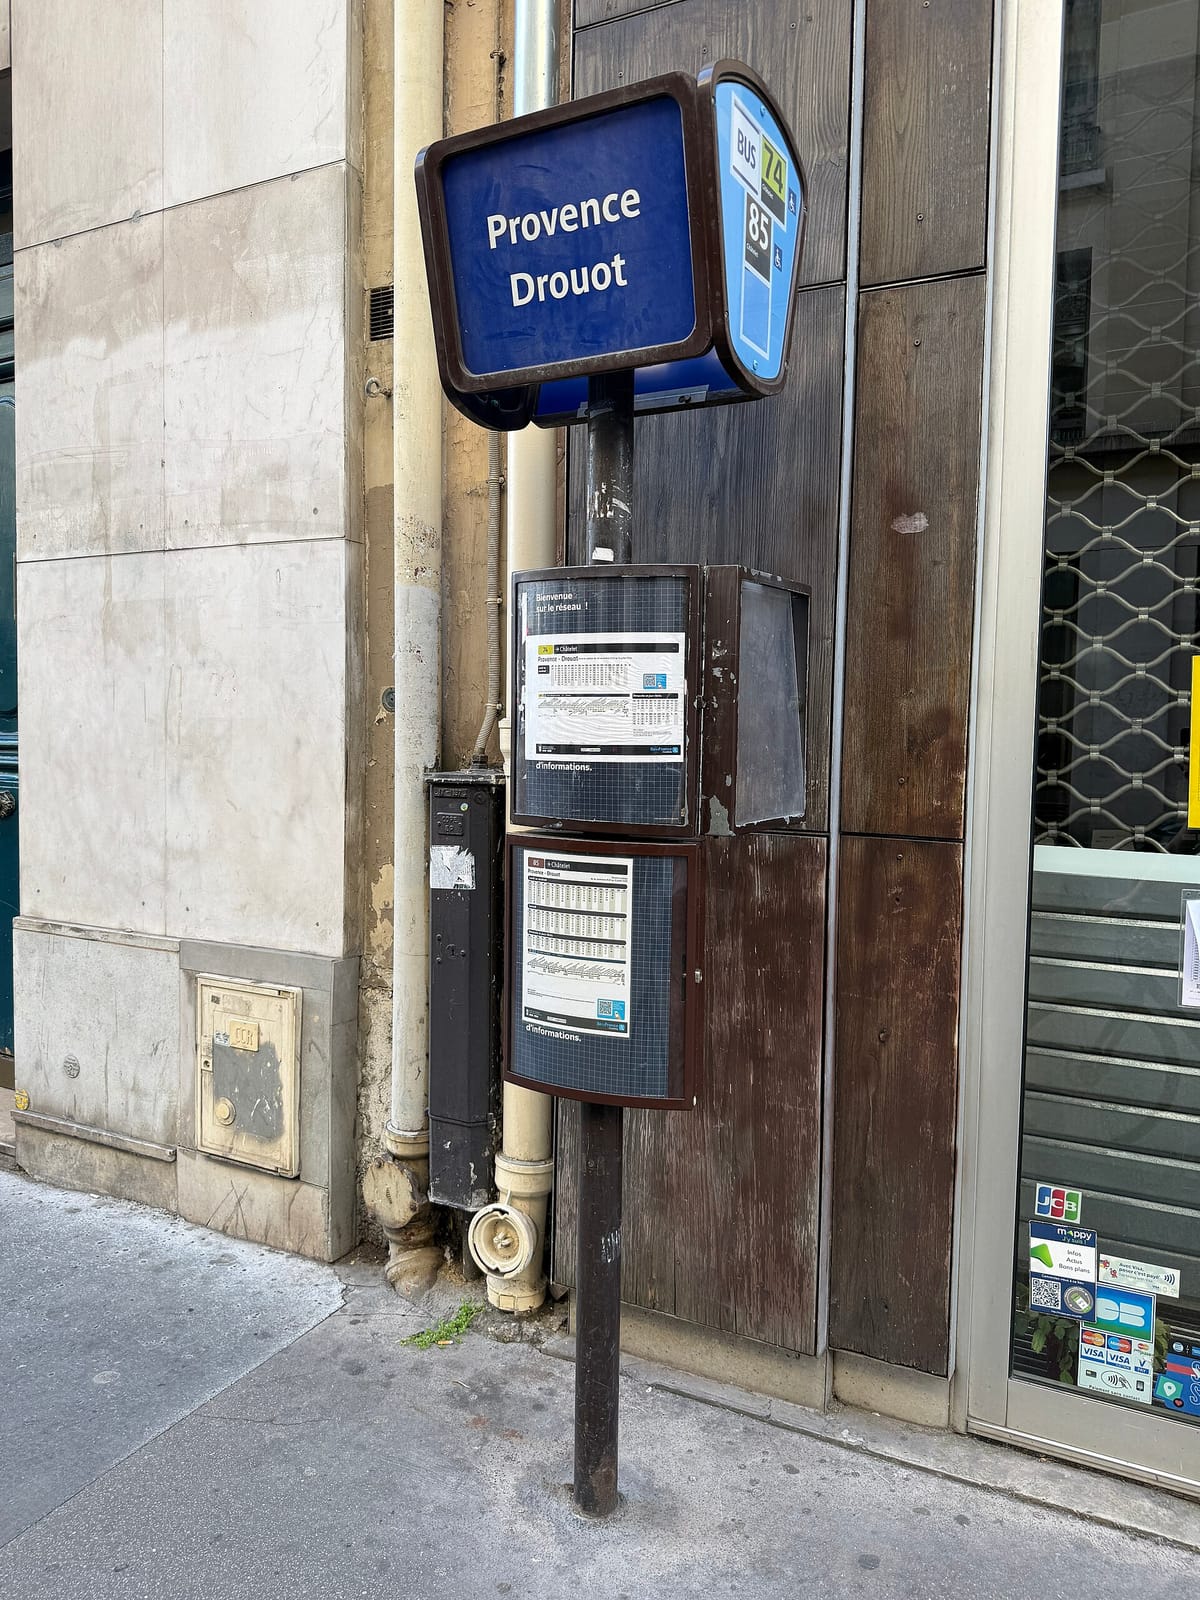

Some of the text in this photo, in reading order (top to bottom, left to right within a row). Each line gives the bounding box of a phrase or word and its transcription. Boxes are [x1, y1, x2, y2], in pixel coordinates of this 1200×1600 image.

[737, 127, 756, 170] BUS
[764, 142, 785, 194] 74
[486, 188, 641, 249] Provence
[749, 202, 769, 250] 85
[509, 253, 628, 307] Drouot
[536, 592, 573, 602] Bienvenue
[556, 603, 582, 611] réseau
[536, 761, 593, 772] d'informations.
[526, 1024, 582, 1042] d'informations.
[1038, 1196, 1077, 1212] JCB
[1058, 1263, 1074, 1271] Bons
[1084, 1347, 1104, 1358] VISA
[1110, 1354, 1130, 1364] VISA
